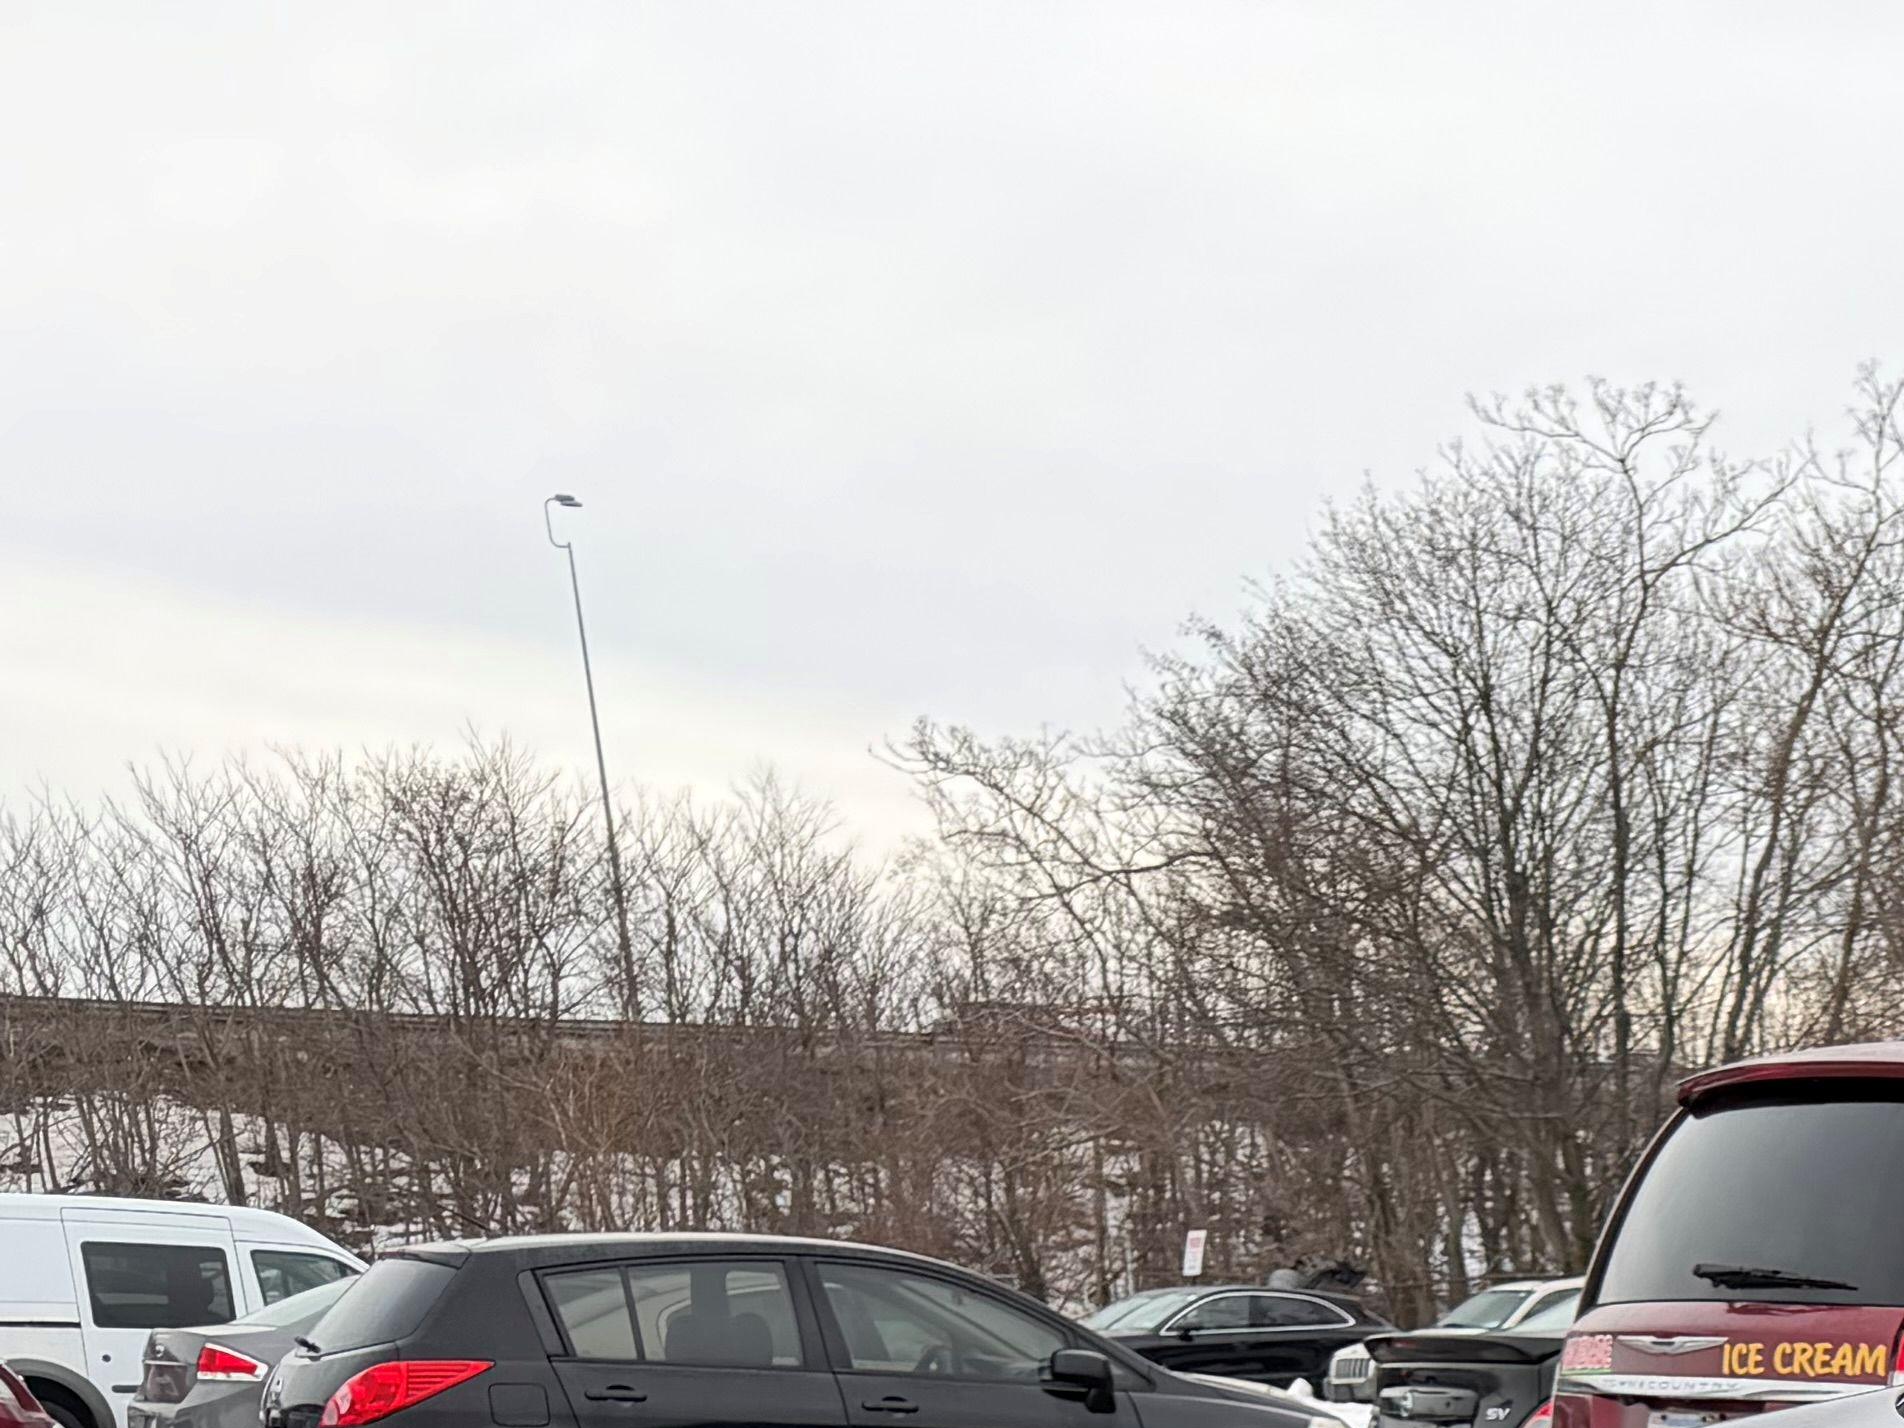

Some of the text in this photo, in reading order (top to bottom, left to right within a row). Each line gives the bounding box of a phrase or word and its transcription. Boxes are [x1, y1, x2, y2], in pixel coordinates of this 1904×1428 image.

[1721, 1342, 1888, 1377] ICE CREAM
[1485, 1407, 1511, 1421] SV
